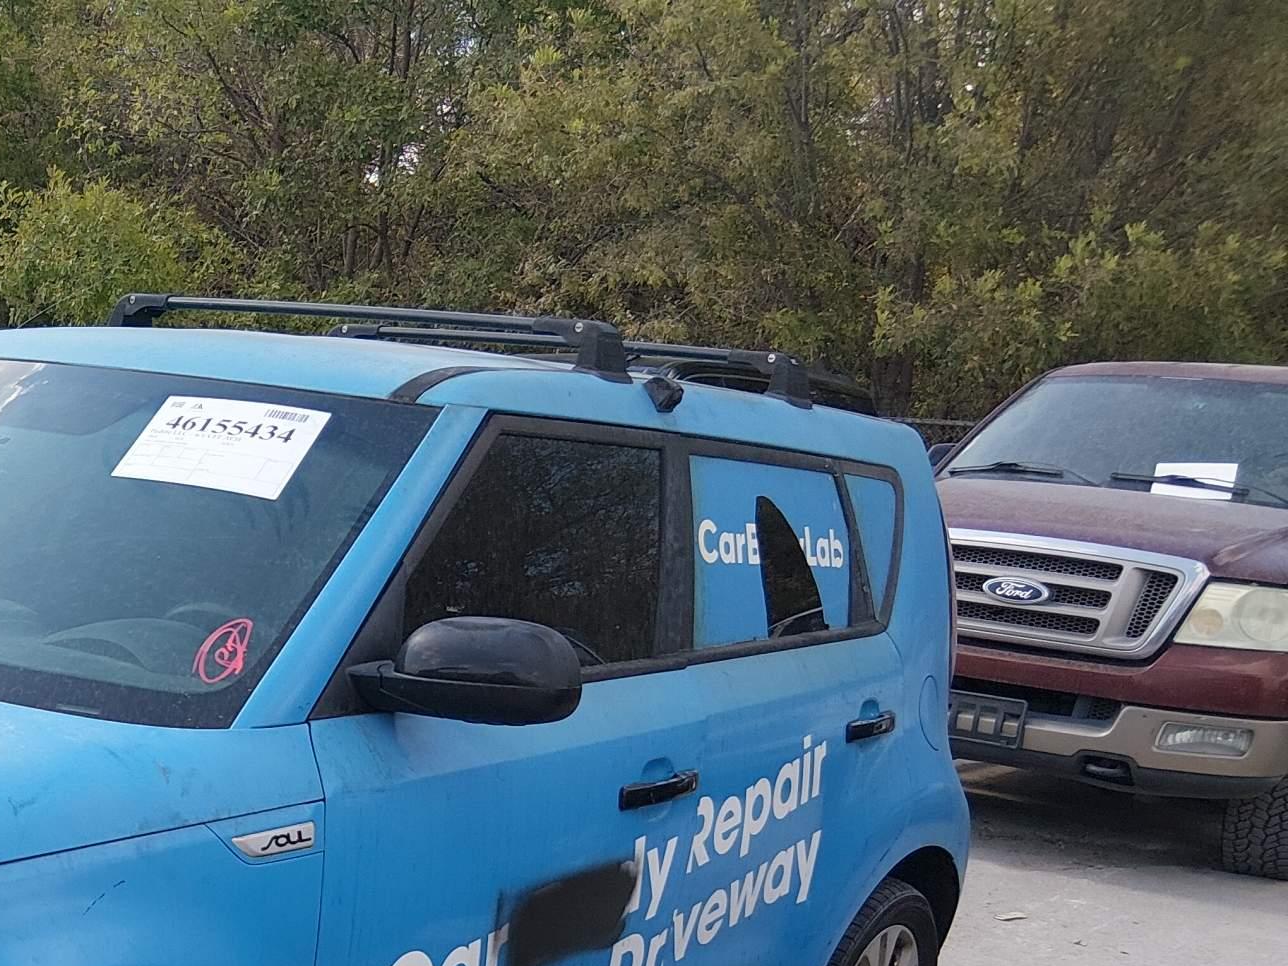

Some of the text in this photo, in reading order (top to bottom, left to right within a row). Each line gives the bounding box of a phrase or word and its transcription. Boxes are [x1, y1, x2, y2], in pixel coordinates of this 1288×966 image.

[165, 414, 297, 444] 46155434
[995, 582, 1033, 599] Ford
[686, 734, 827, 875] Repair
